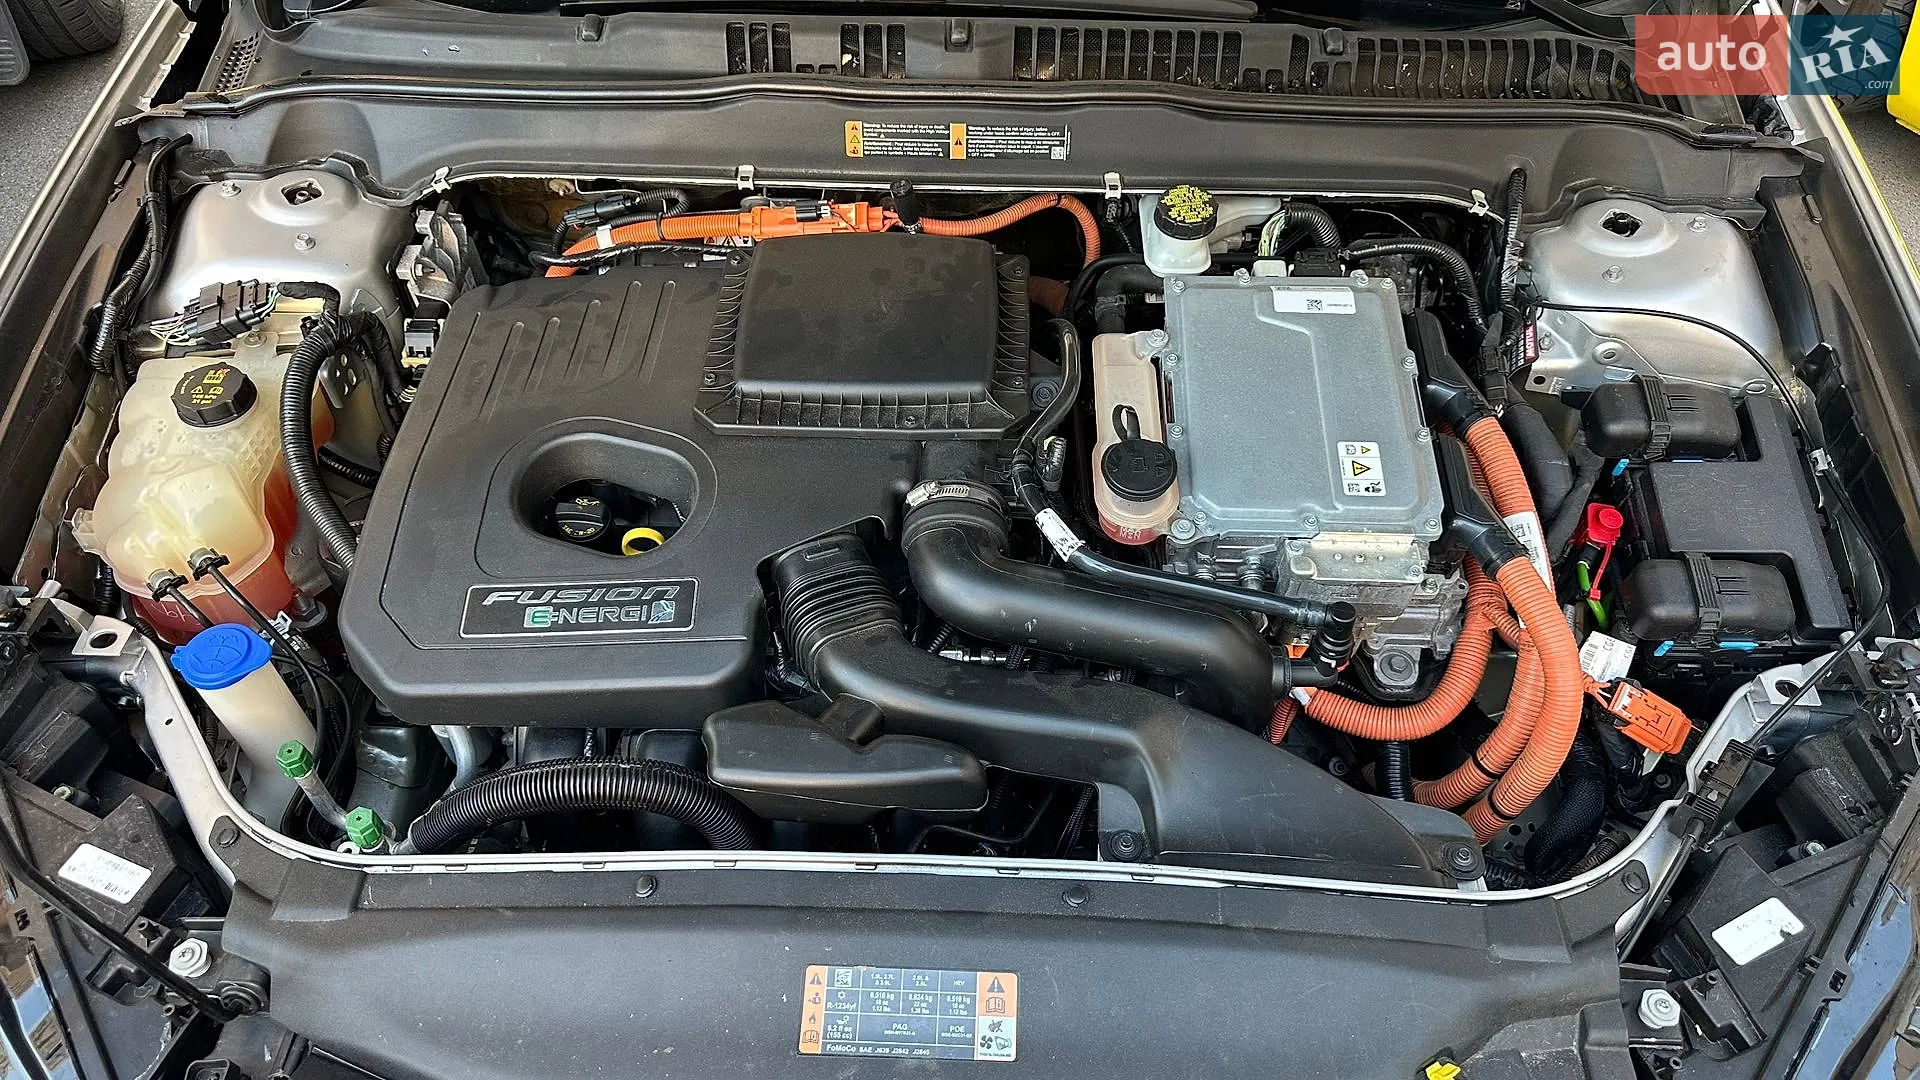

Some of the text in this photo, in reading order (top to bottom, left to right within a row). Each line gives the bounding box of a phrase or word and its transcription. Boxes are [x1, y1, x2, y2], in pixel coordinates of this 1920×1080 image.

[1525, 324, 1535, 357] MOTUL
[482, 585, 681, 606] FUSION
[827, 1002, 857, 1011] R-1234yf
[949, 1025, 965, 1033] POE
[826, 1044, 857, 1053] FoMoCo
